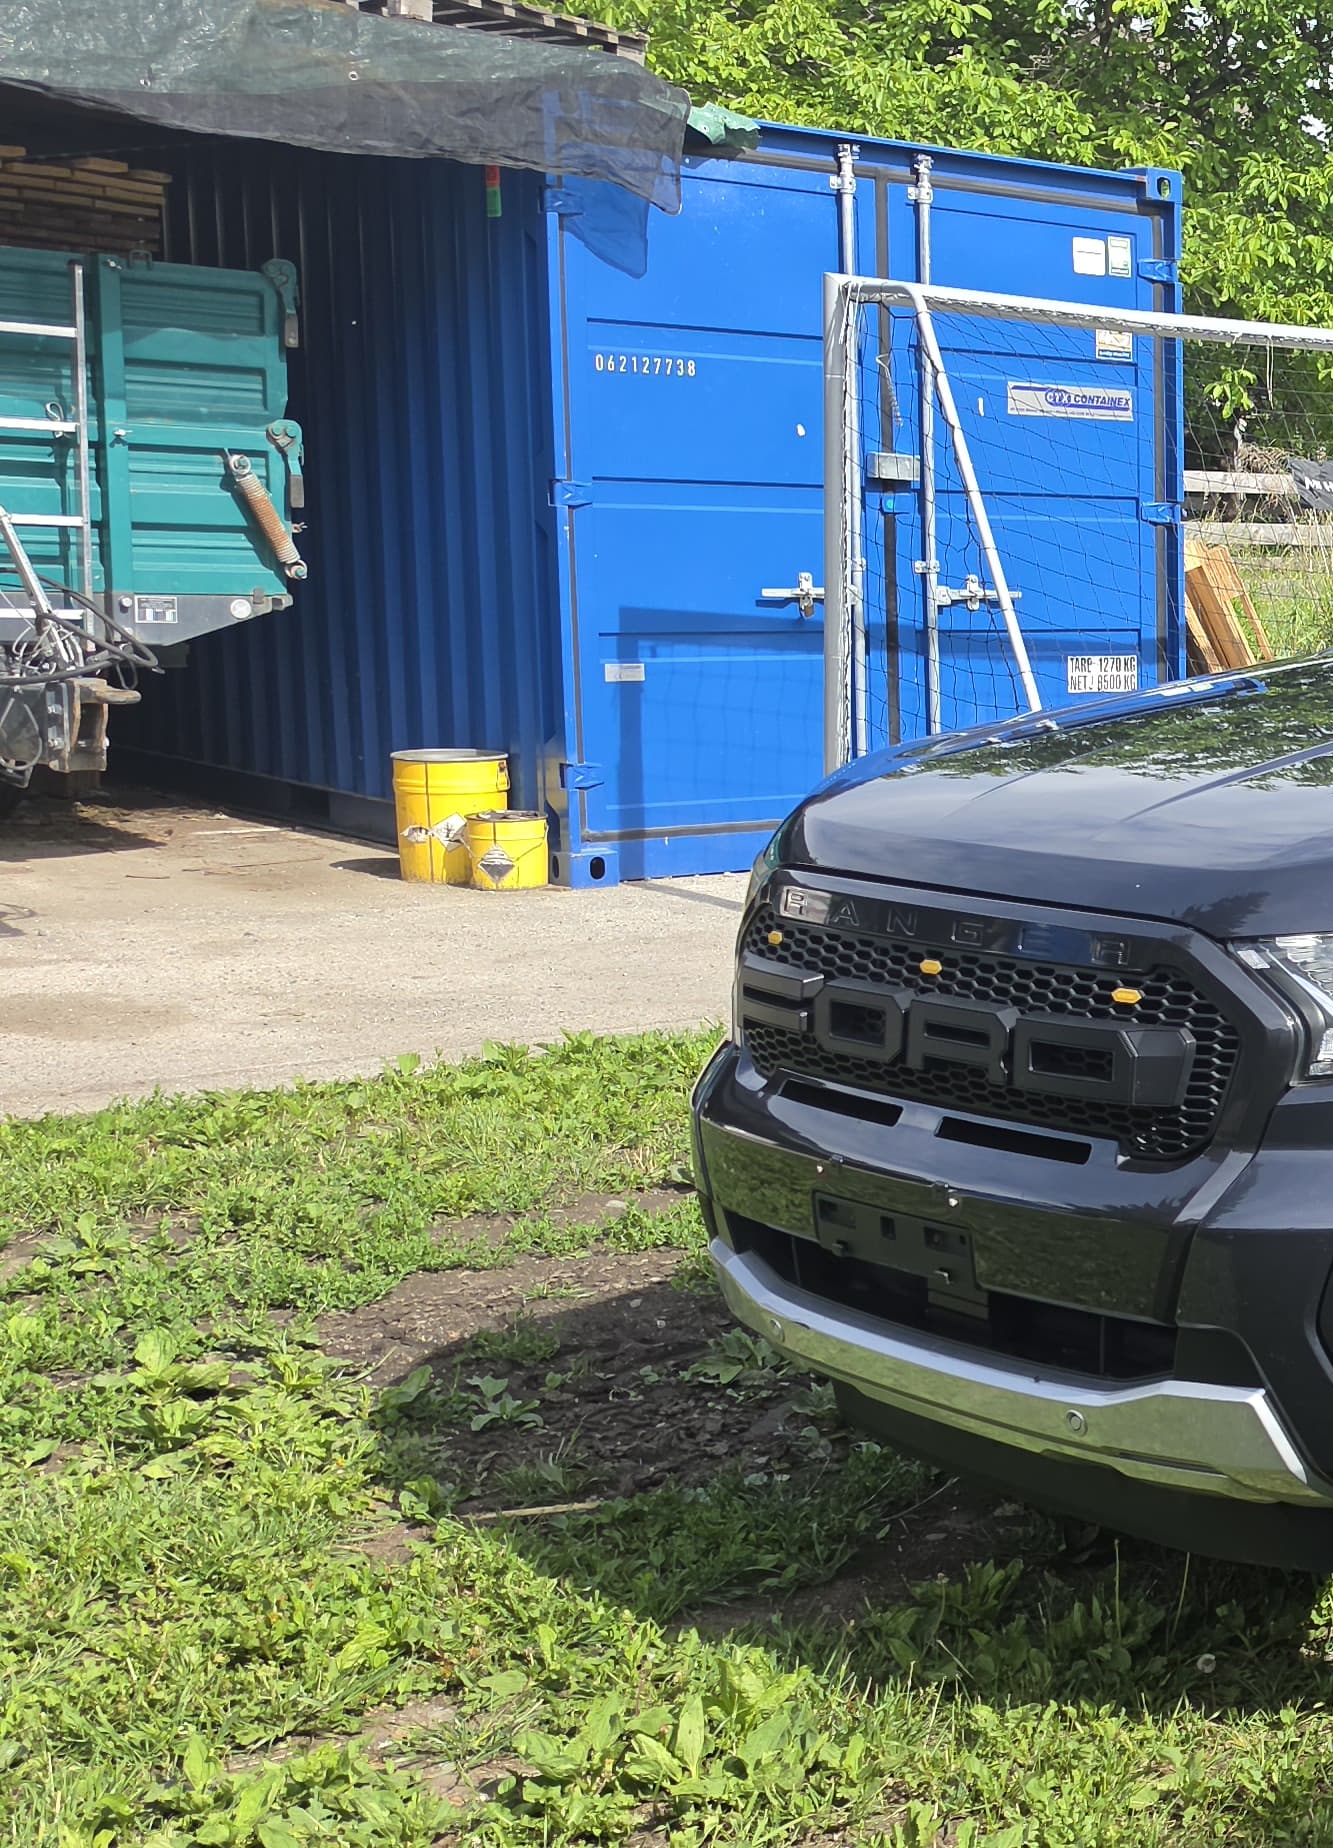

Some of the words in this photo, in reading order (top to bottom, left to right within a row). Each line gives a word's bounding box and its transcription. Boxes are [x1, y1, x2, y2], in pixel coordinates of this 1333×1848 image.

[594, 353, 696, 377] 062127738
[1073, 394, 1131, 407] CONTAINEX
[1099, 656, 1122, 673] 1270
[1123, 656, 1136, 673] KG
[1123, 674, 1136, 691] KG
[783, 886, 1131, 967] RANGER
[737, 952, 1197, 1108] FORD
